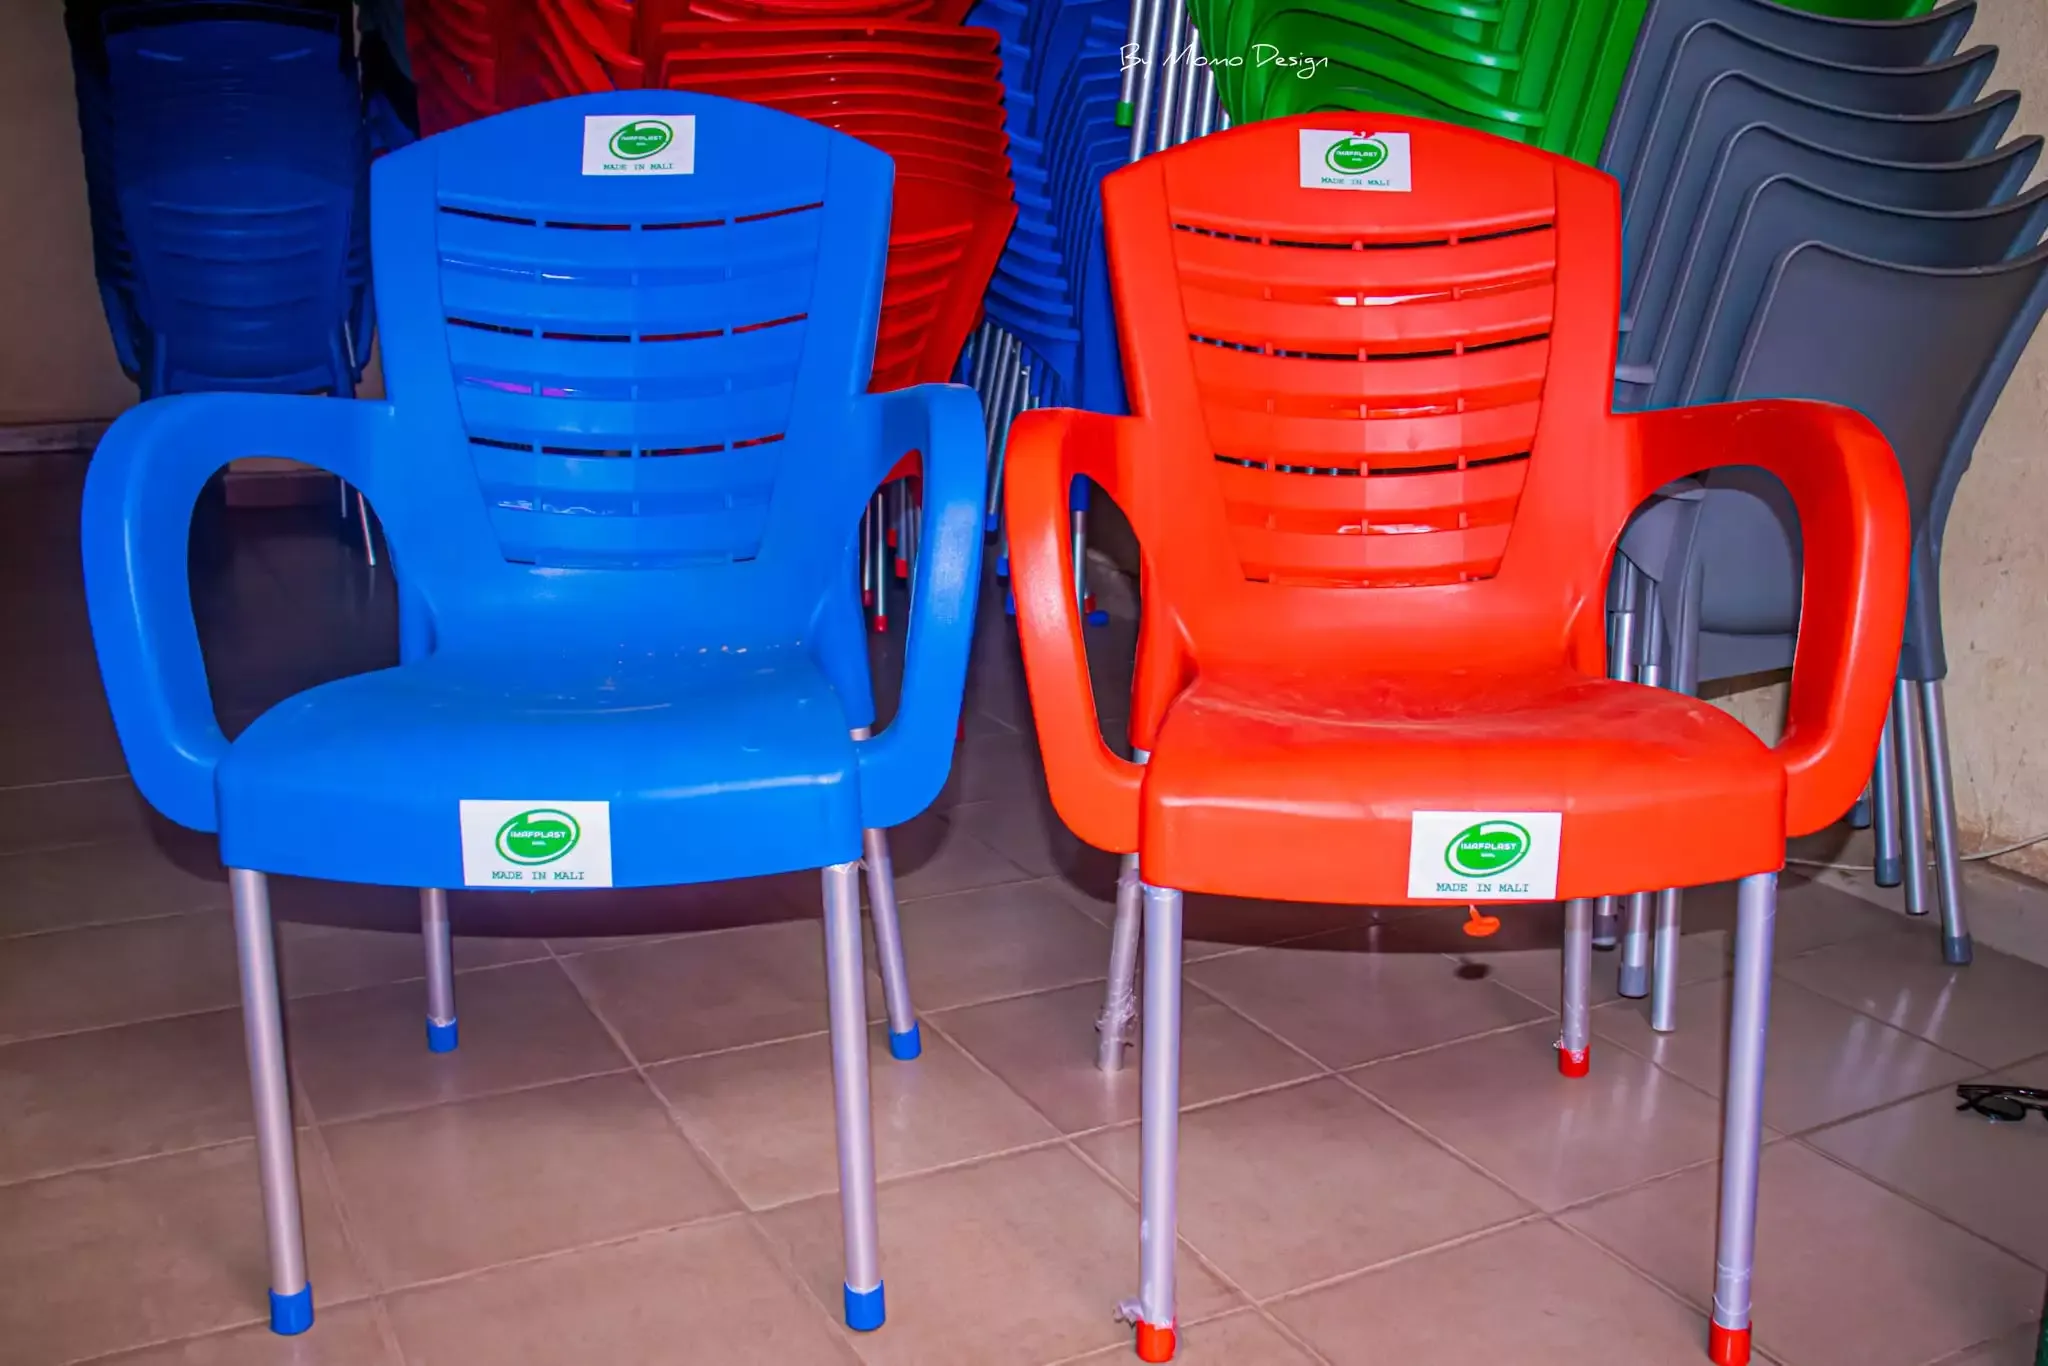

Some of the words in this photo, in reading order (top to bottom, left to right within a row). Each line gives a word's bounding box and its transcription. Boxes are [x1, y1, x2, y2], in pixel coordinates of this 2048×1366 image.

[492, 871, 523, 880] MADE
[532, 871, 546, 880] IN
[554, 871, 584, 880] MALI
[1436, 883, 1468, 892] MADE
[1477, 883, 1491, 892] IN
[1499, 884, 1529, 892] MALI
